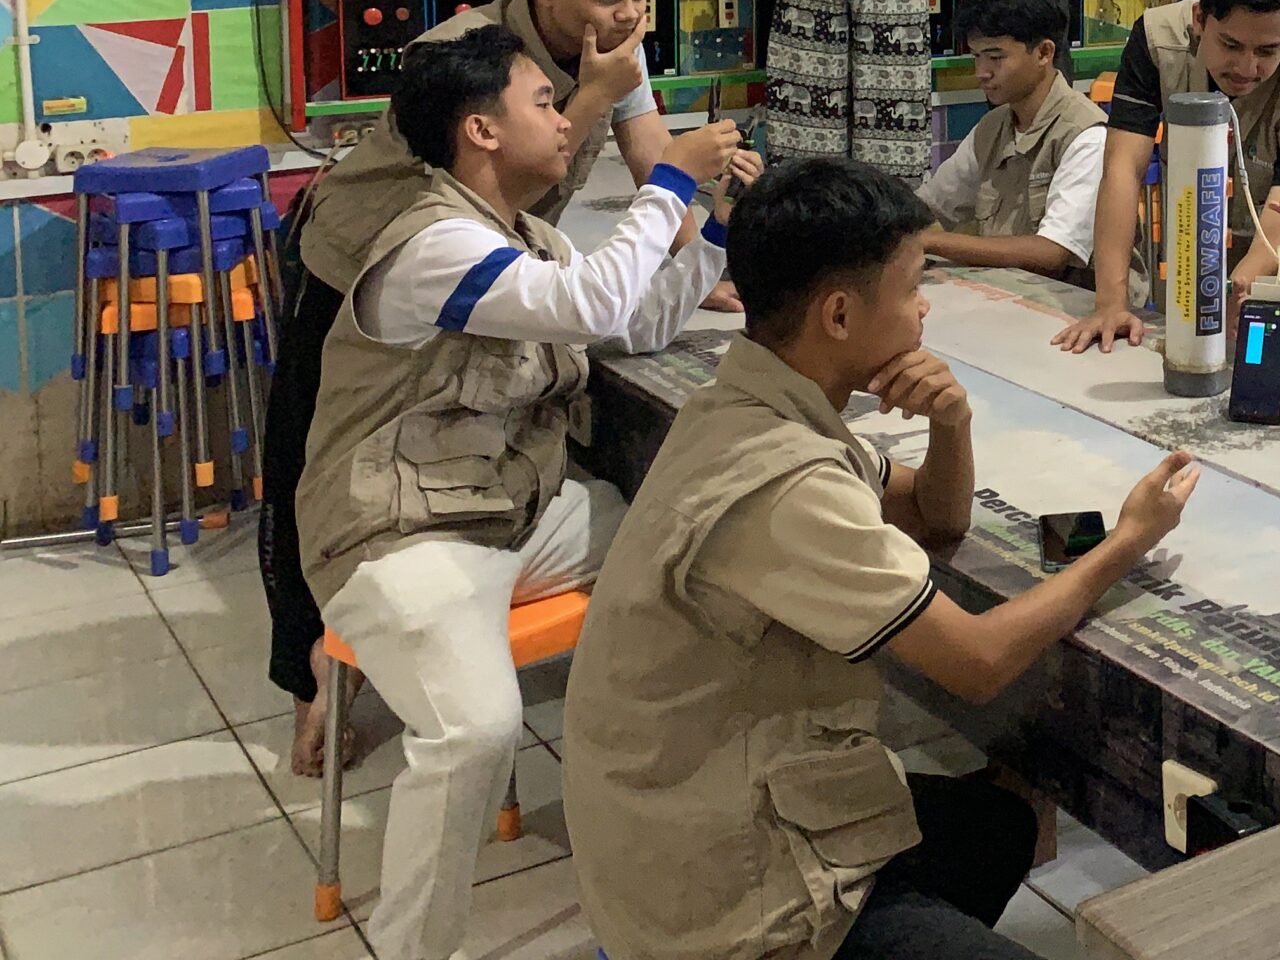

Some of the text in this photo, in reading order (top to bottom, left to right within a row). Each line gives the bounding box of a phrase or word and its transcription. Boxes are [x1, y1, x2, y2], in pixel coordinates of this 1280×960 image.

[1200, 173, 1221, 330] FLOWSAFE
[1184, 255, 1192, 287] System
[1183, 290, 1192, 318] Safety
[1201, 639, 1240, 660] dan
